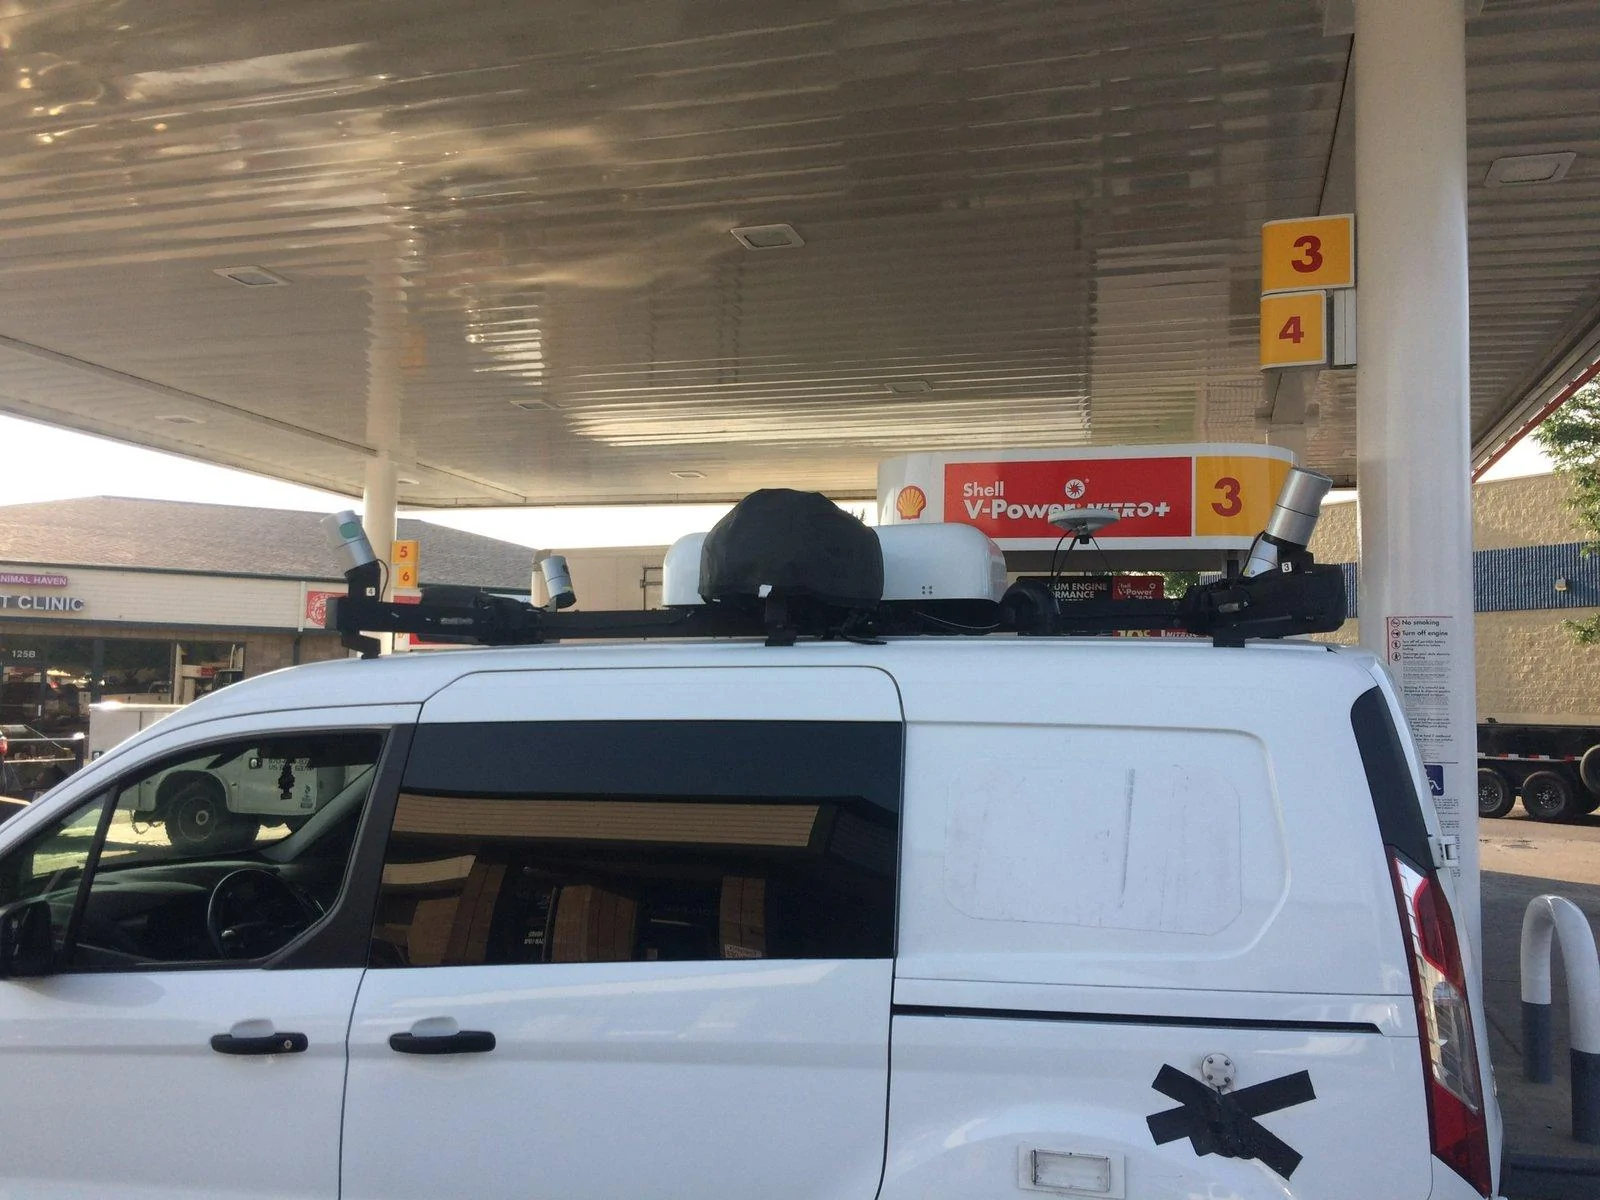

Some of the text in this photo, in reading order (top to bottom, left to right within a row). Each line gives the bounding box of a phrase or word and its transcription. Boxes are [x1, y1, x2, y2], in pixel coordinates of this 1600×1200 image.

[1291, 235, 1323, 273] 3
[1279, 316, 1304, 344] 4
[963, 481, 1004, 497] Shell
[1211, 477, 1242, 517] 3
[400, 546, 408, 558] 5
[1284, 563, 1290, 571] 3
[0, 574, 67, 586] NIMAL HAVEN
[403, 572, 409, 581] 6
[1072, 583, 1107, 591] ENGINE
[1053, 590, 1095, 599] RMANCE
[18, 595, 84, 611] CLINIC
[1413, 619, 1440, 627] smoking
